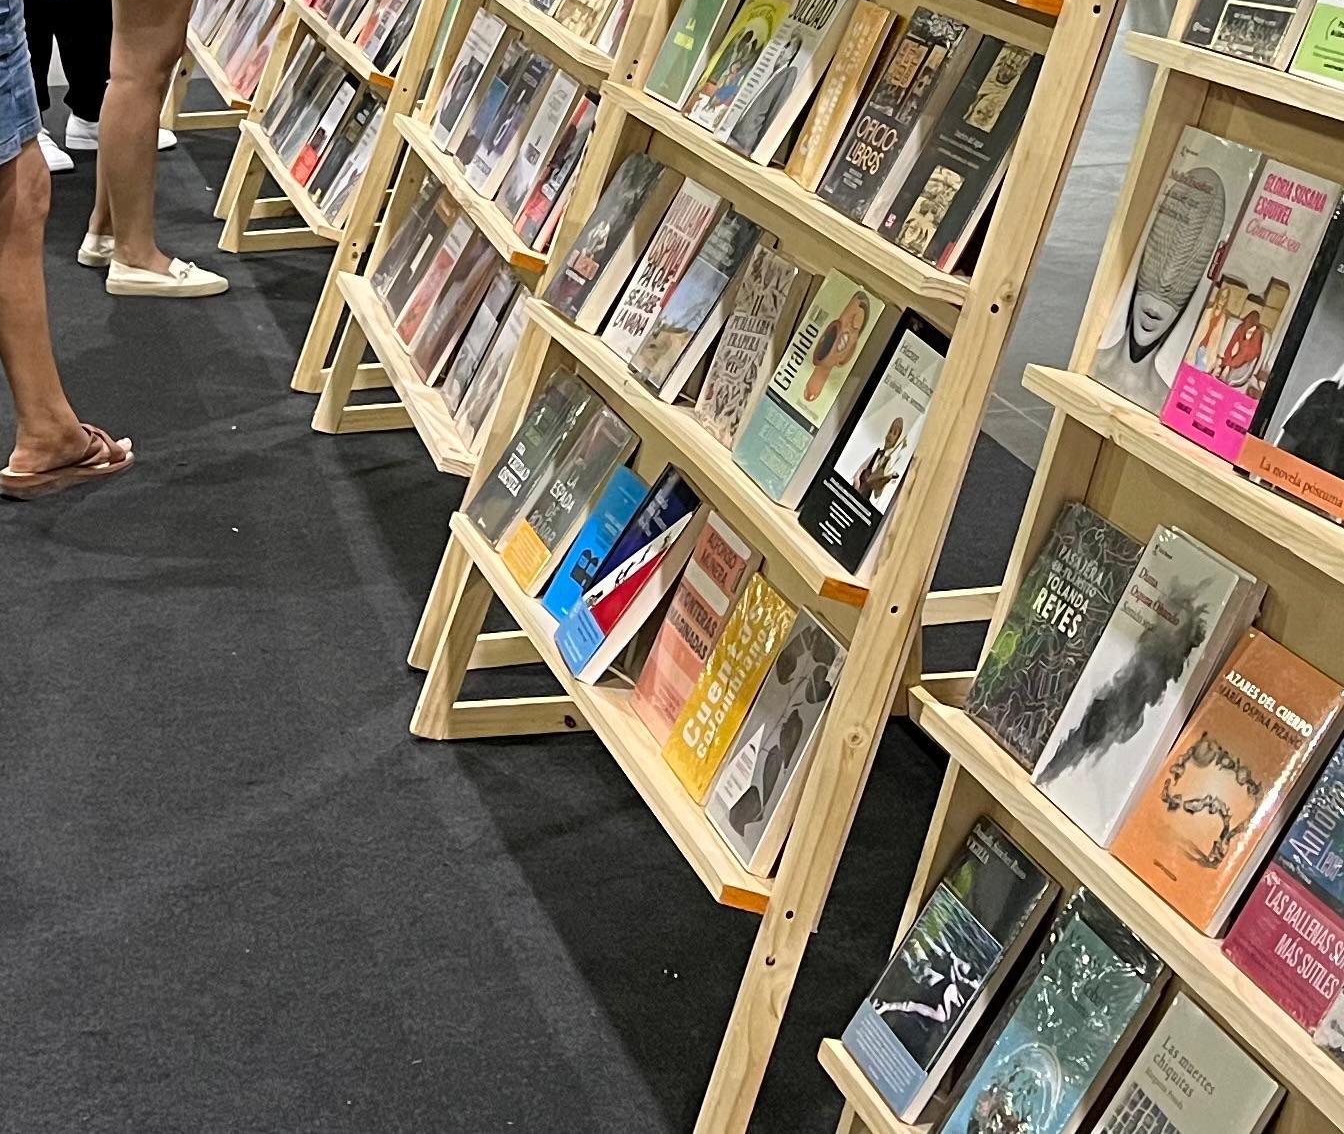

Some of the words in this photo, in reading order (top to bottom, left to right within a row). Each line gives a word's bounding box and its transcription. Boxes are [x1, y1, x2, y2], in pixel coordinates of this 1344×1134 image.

[774, 323, 819, 391] Giraldo
[550, 479, 576, 514] ESPADA
[1259, 457, 1271, 471] La
[1273, 468, 1301, 487] novela
[1058, 545, 1104, 586] PASAJERA
[1032, 587, 1082, 638] REYES
[1046, 572, 1090, 614] YOLANDA
[1224, 670, 1260, 700] AZARES
[1258, 693, 1276, 712] DEL
[1276, 706, 1313, 737] CUERPO
[1242, 703, 1271, 729] OSPINA
[1271, 723, 1302, 750] PIZANO
[1265, 884, 1289, 915] LAS
[1282, 900, 1335, 954] BALLENAS
[1274, 933, 1300, 967] MÁS
[1297, 953, 1339, 999] SUTILES
[1153, 1053, 1194, 1097] chiquitas
[1162, 1035, 1179, 1058] Las
[1178, 1056, 1215, 1095] muertes
